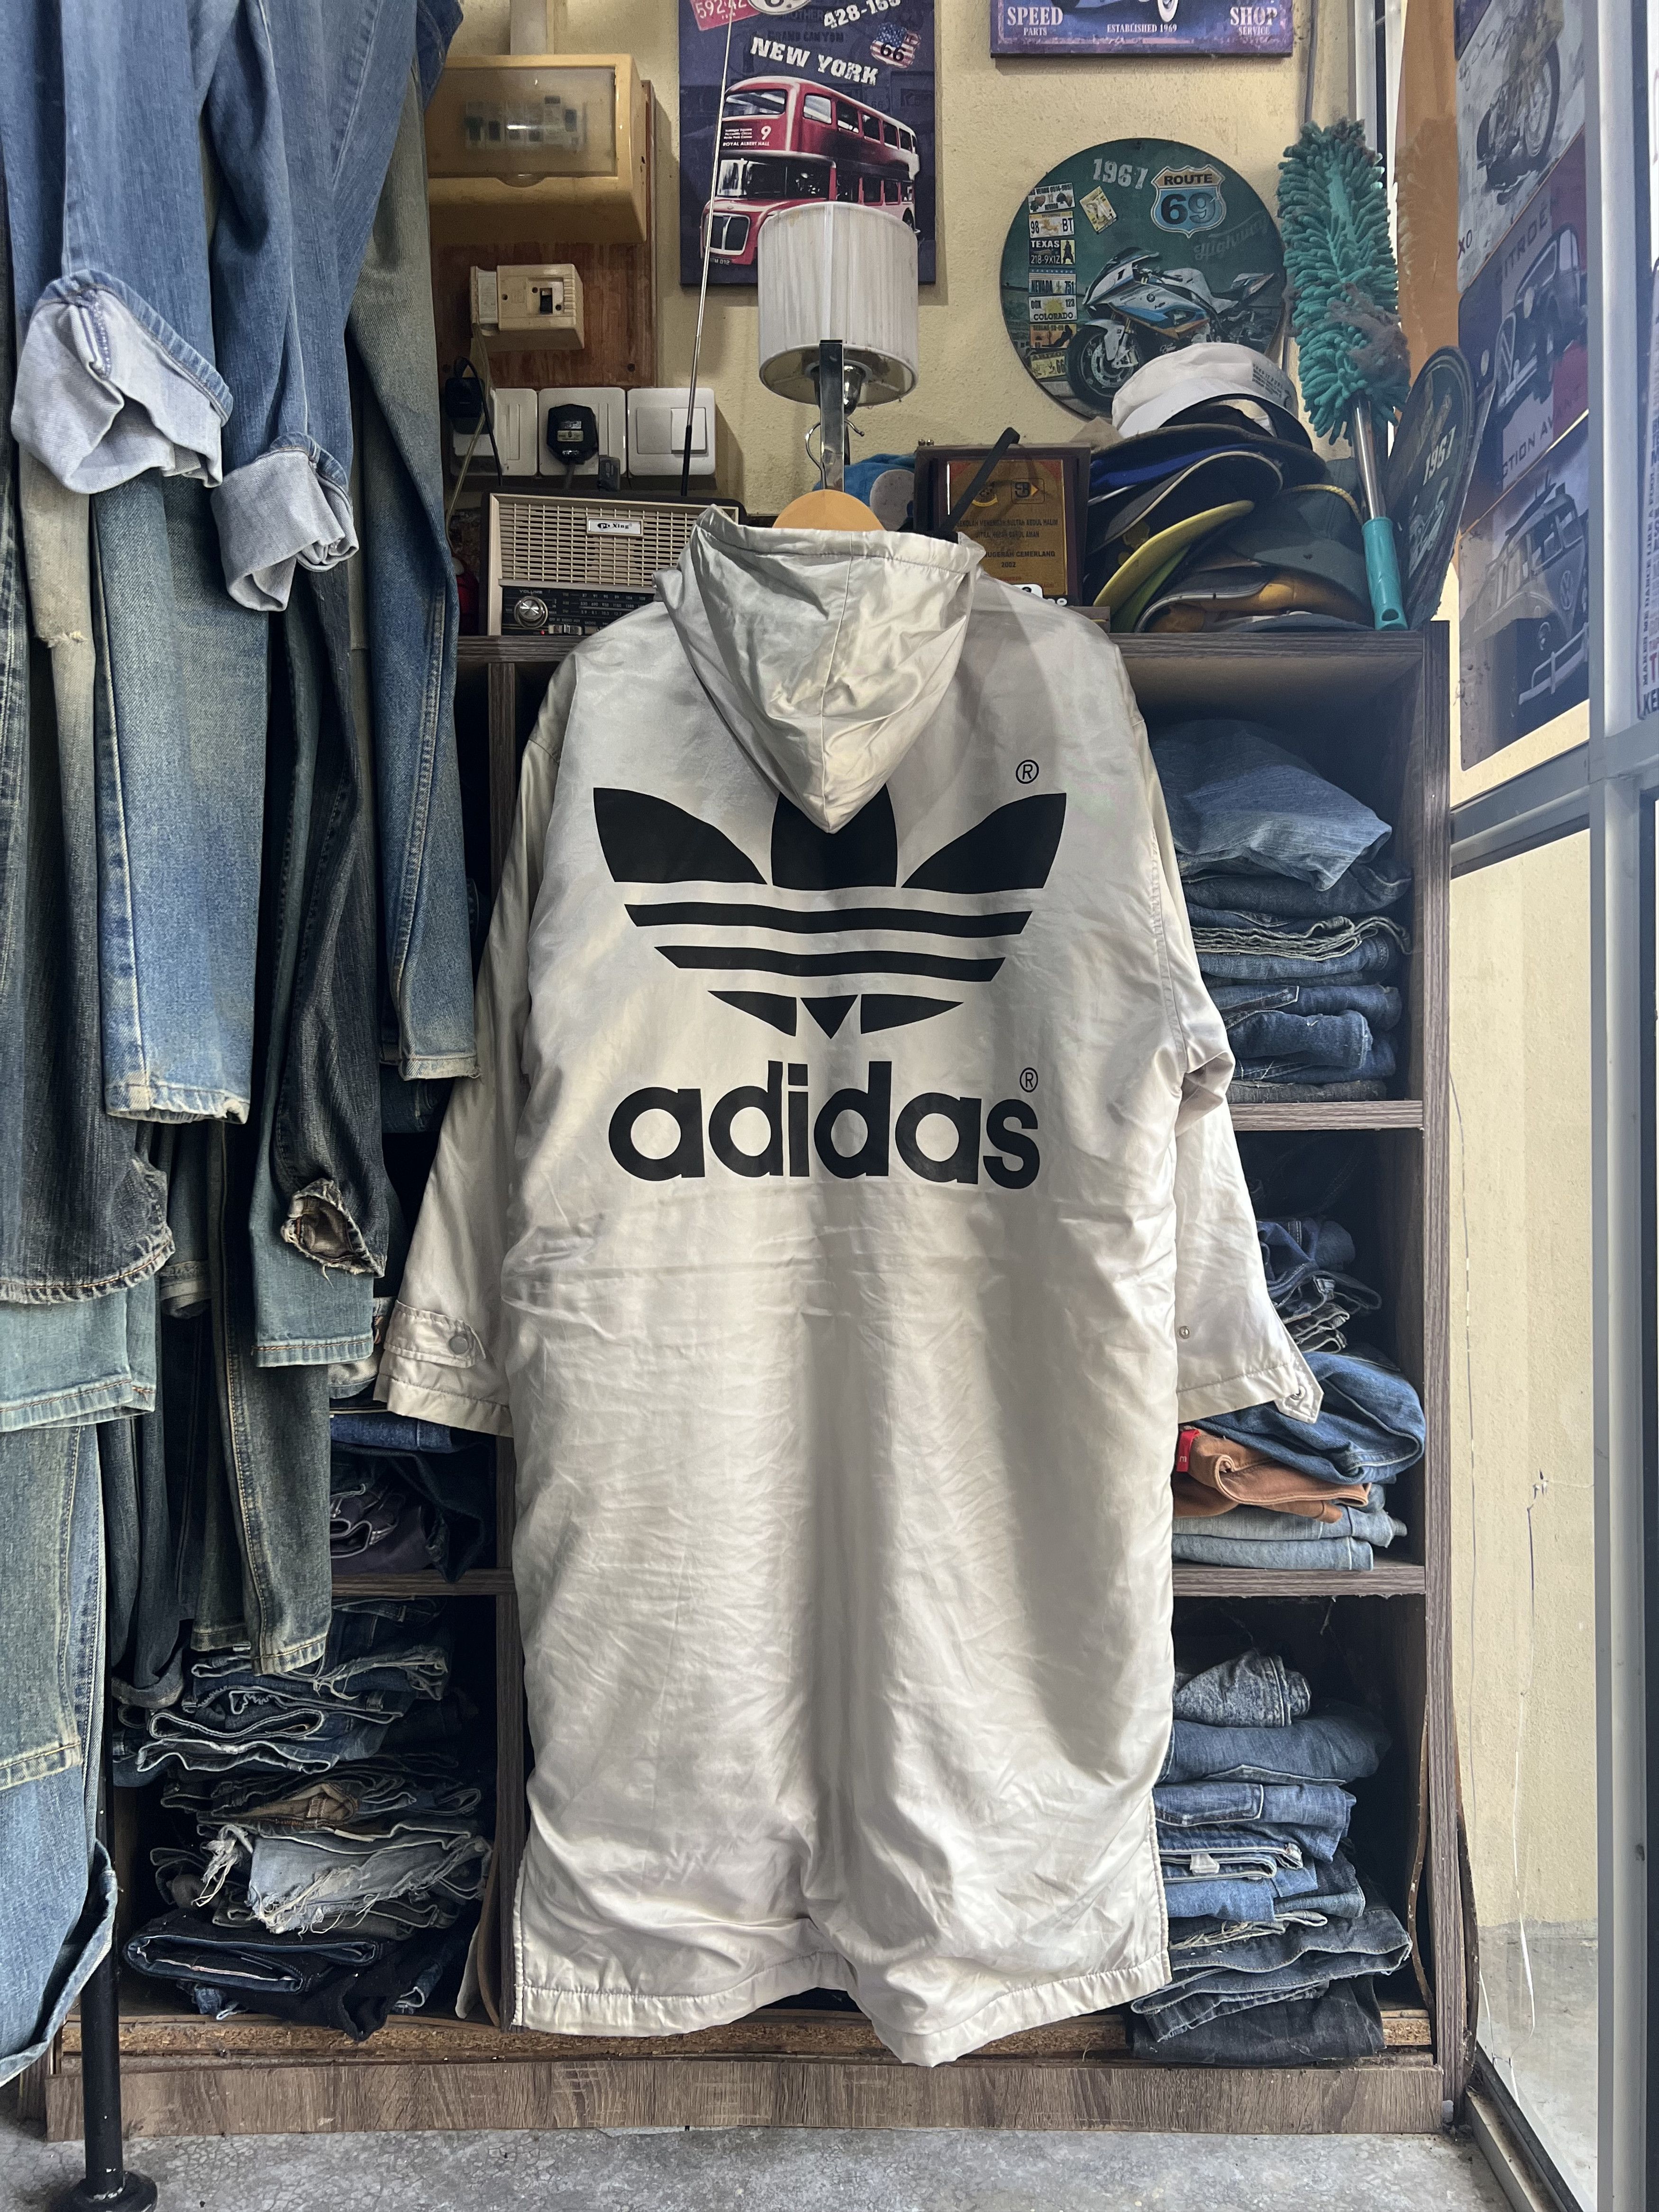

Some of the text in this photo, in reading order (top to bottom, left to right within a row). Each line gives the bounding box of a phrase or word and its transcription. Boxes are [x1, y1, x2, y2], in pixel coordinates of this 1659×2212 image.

[1007, 7, 1063, 26] SPEED
[1230, 7, 1277, 26] SHOP
[1023, 27, 1047, 36] PARTS
[1107, 24, 1177, 33] ESTABLISHED 1969
[1238, 27, 1270, 36] SERVICE
[750, 36, 878, 86] NEW YORK
[881, 44, 906, 62] 66
[761, 126, 772, 140] 9
[1164, 173, 1213, 185] ROUTE
[1160, 192, 1216, 225] 69
[1030, 218, 1073, 234] 98 BT
[1033, 312, 1073, 321] COLORADO
[1423, 424, 1457, 485] 1967
[609, 1060, 1040, 1189] adidas
